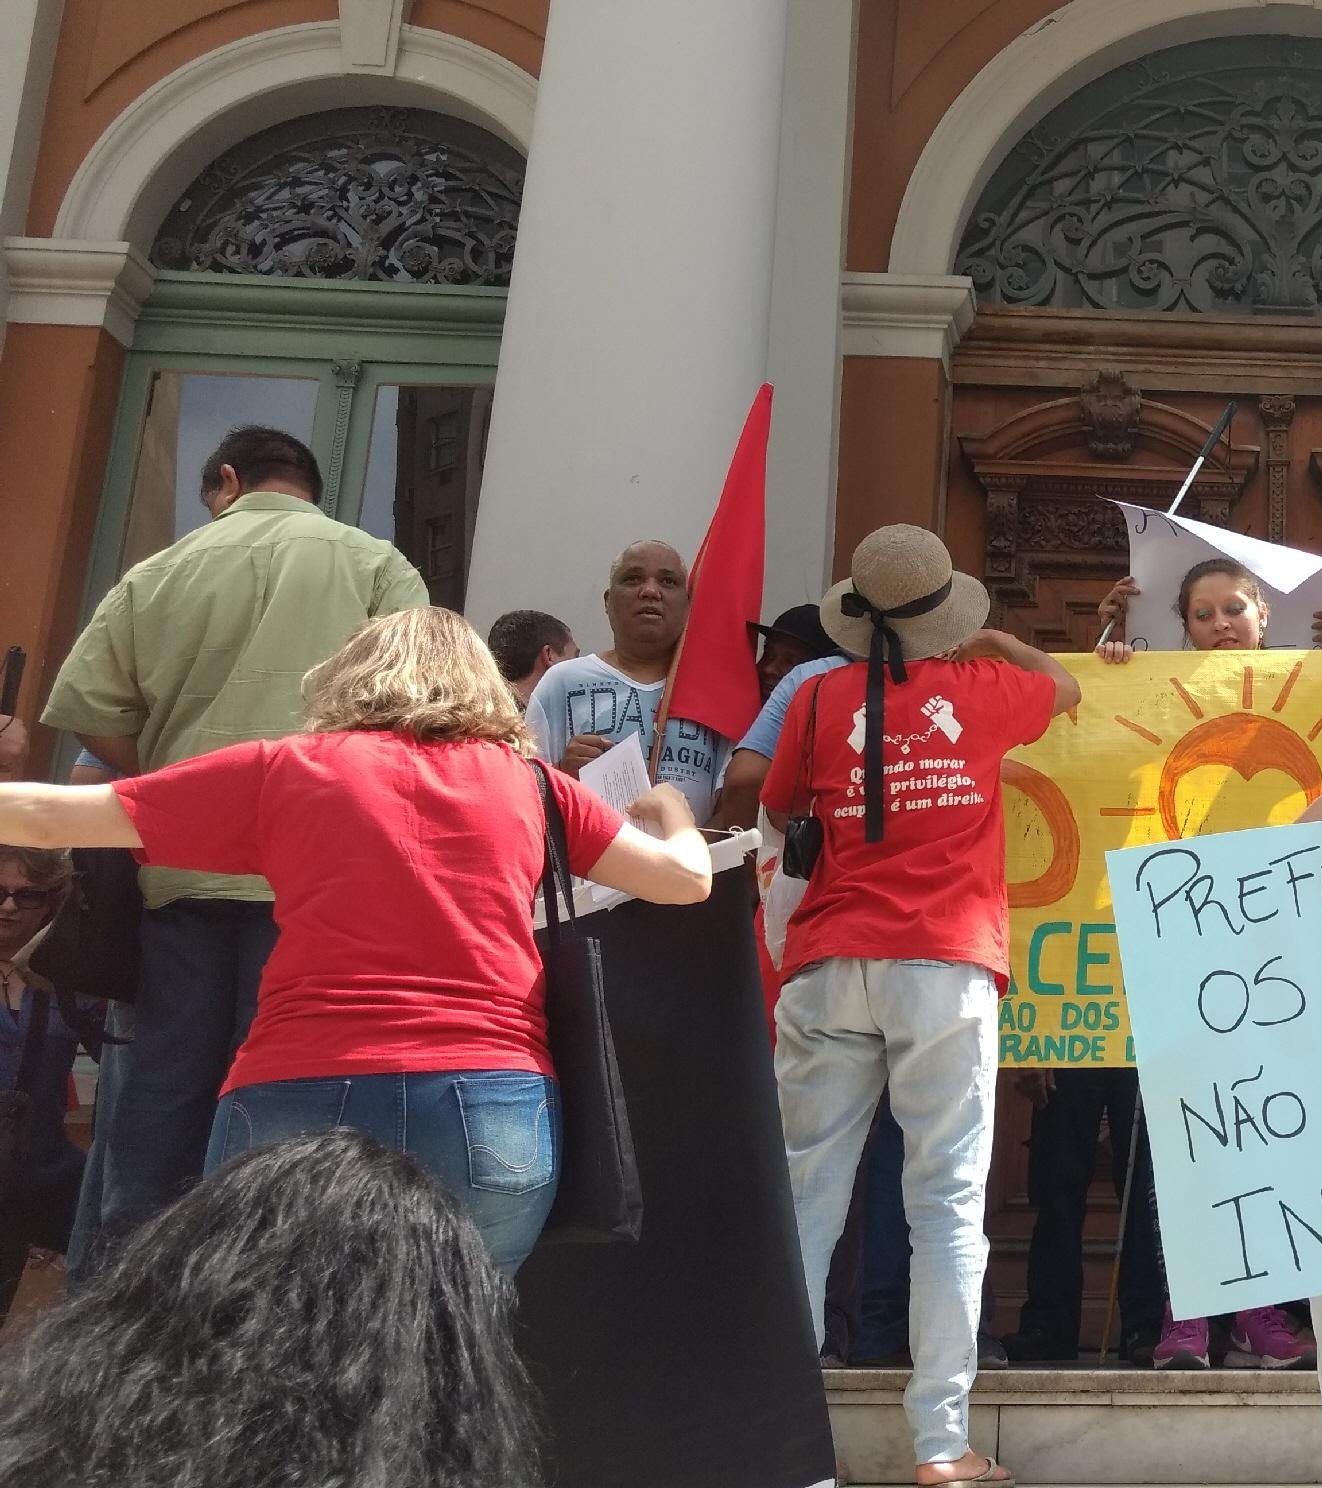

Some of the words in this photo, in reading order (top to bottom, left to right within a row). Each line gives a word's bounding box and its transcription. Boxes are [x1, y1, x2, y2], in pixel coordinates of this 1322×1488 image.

[846, 785, 857, 798] é
[889, 773, 976, 795] privilégio,
[849, 760, 915, 785] Qndo
[918, 758, 966, 770] morar
[890, 798, 901, 812] é
[905, 798, 933, 812] um
[1197, 955, 1307, 1034] OS
[998, 997, 1037, 1033] ÃO
[1060, 1001, 1120, 1031] DOS
[1000, 1034, 1106, 1063] RANDE
[1179, 1064, 1307, 1163] NÃO
